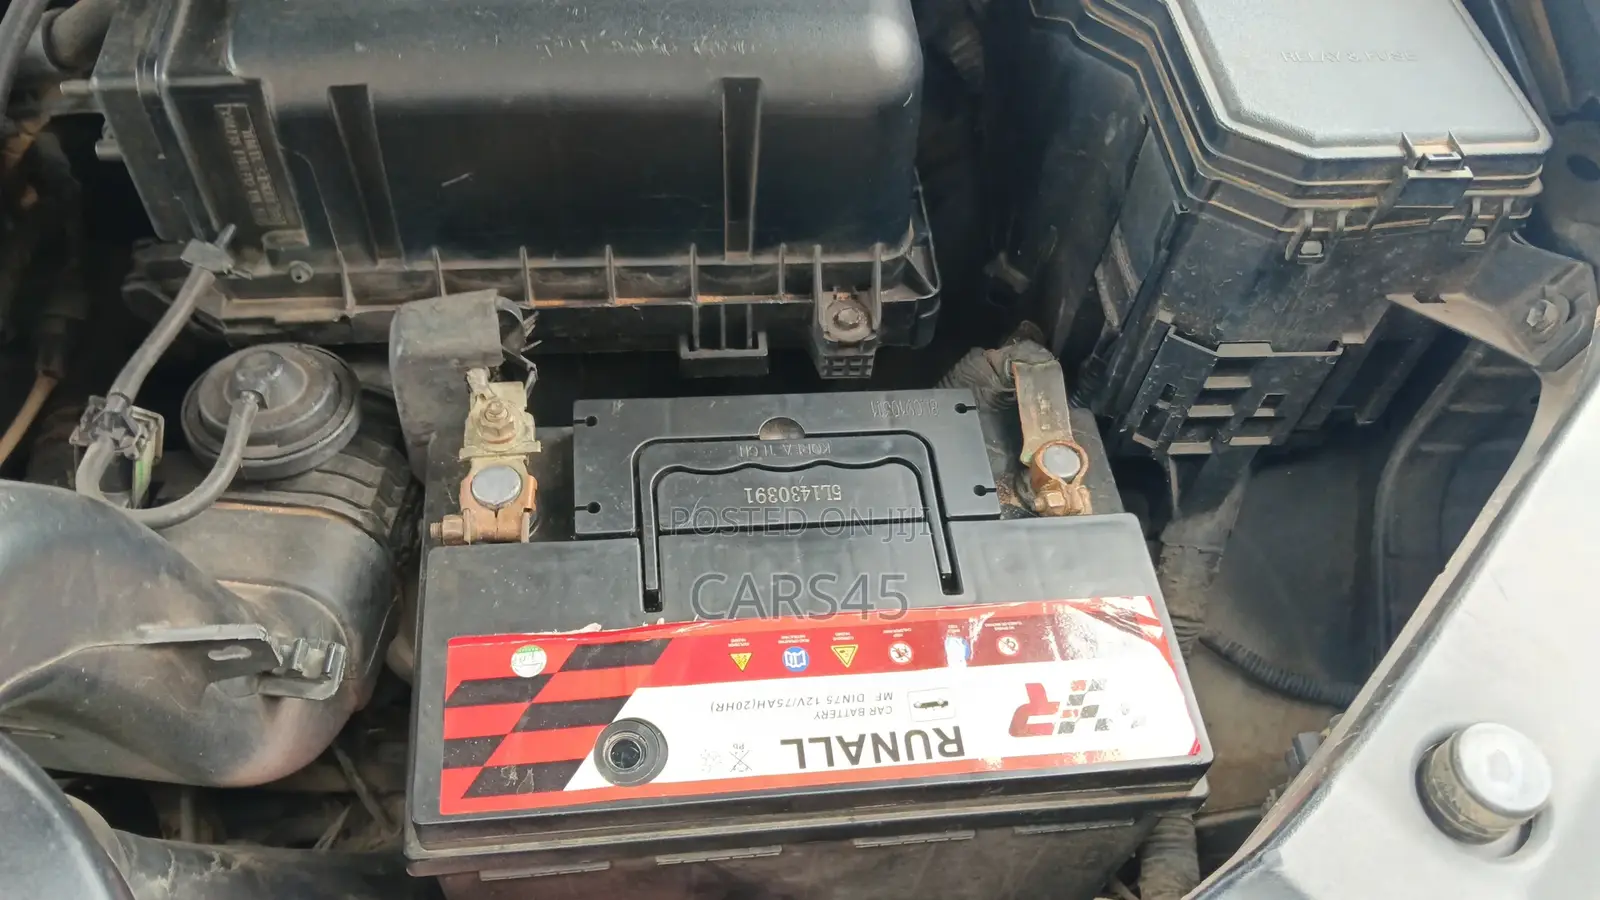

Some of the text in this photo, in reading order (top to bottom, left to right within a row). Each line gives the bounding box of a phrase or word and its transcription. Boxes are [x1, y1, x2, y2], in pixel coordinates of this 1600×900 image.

[1280, 50, 1418, 63] RELAY & FUSE
[743, 483, 842, 504] 5L1430391
[709, 691, 893, 714] MF DIN75 12V/75AH(20HR)
[813, 705, 893, 720] CAR BATTERY
[780, 725, 965, 770] RUNALL
